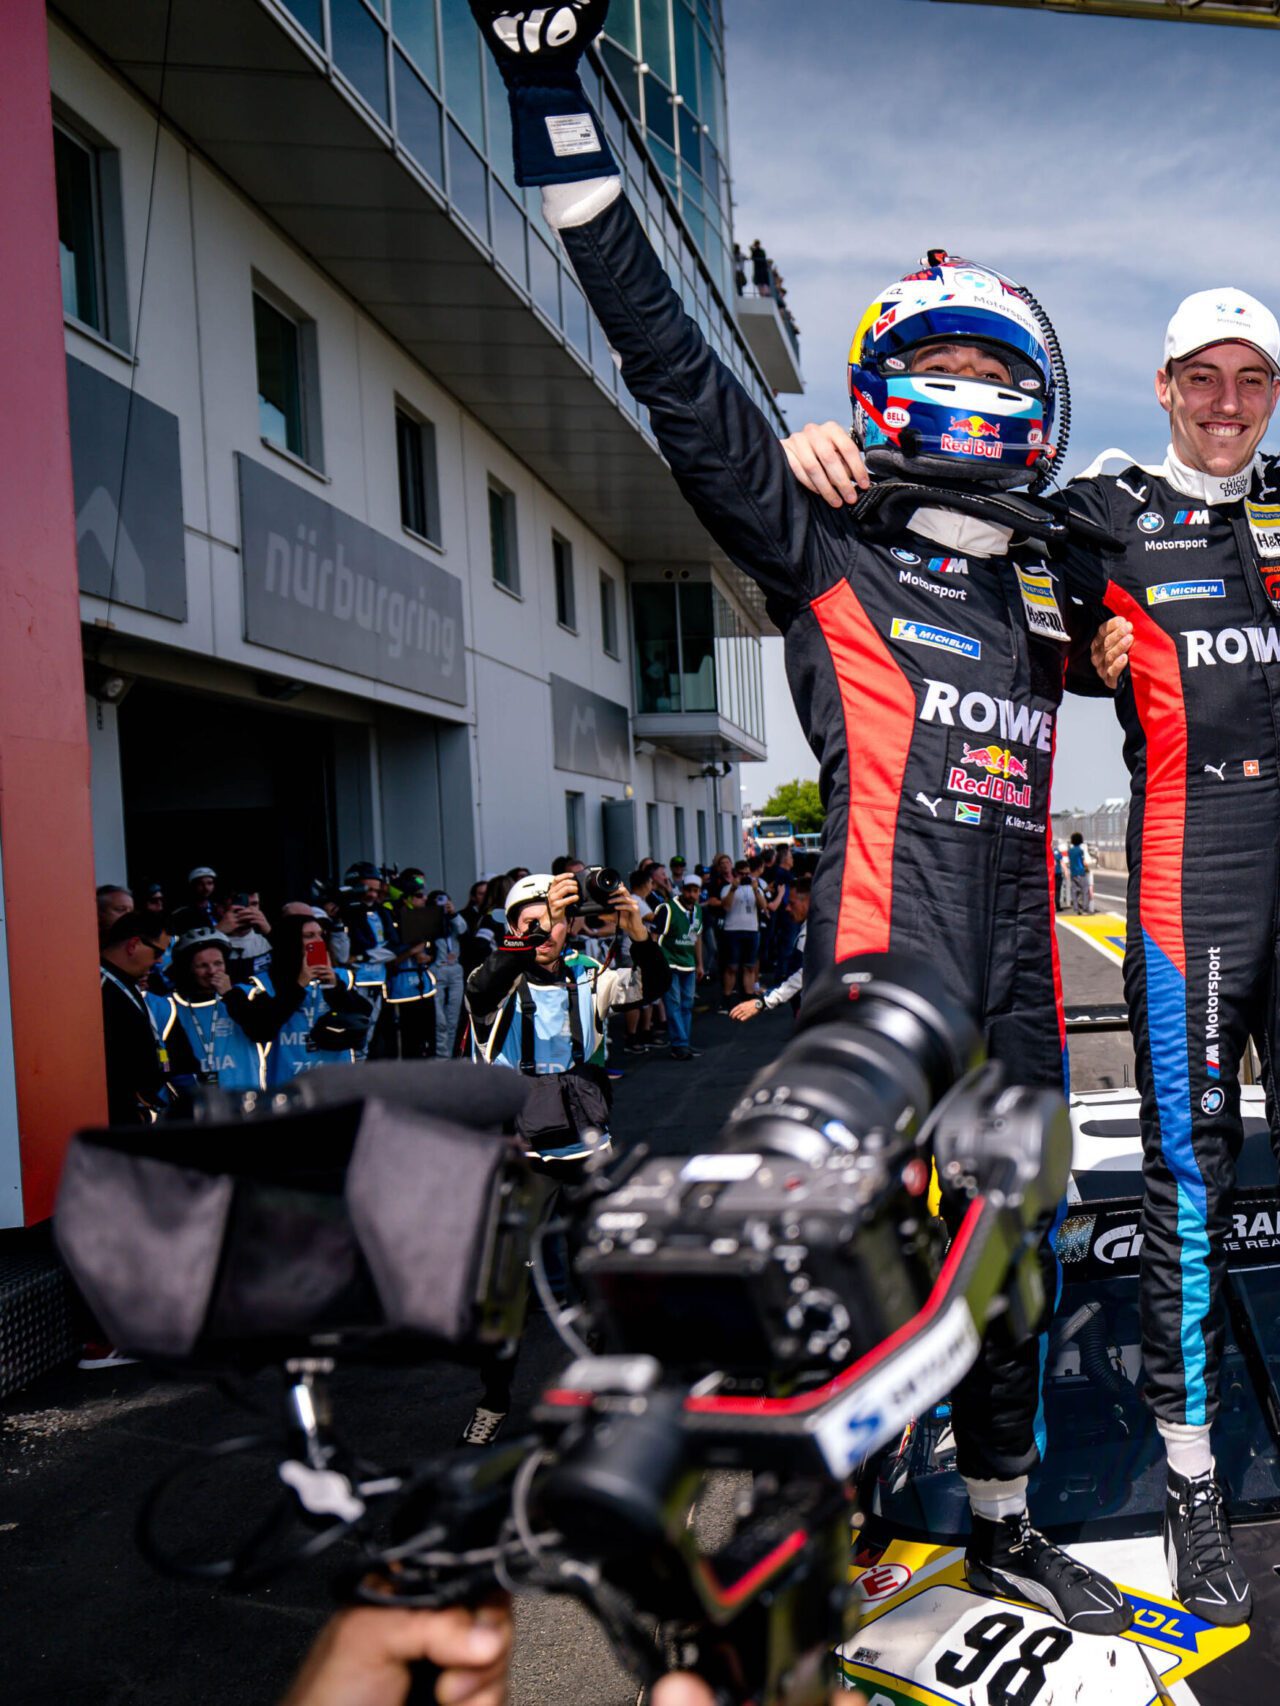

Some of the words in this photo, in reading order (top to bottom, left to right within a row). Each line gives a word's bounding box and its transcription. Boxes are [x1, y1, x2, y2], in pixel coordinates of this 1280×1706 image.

[887, 412, 905, 422] BELL
[940, 434, 974, 454] Red
[974, 438, 1003, 459] Bull
[1145, 538, 1208, 552] Motorsport
[898, 570, 967, 600] Motorsport
[1170, 585, 1219, 596] MICHELIN
[264, 522, 457, 678] nürburgring
[919, 629, 975, 652] MICHELIN
[918, 678, 1053, 753] ROWE
[947, 767, 989, 797] Red
[503, 939, 525, 947] Canon
[1206, 946, 1221, 1039] Motorsport
[935, 1612, 1073, 1706] 98
